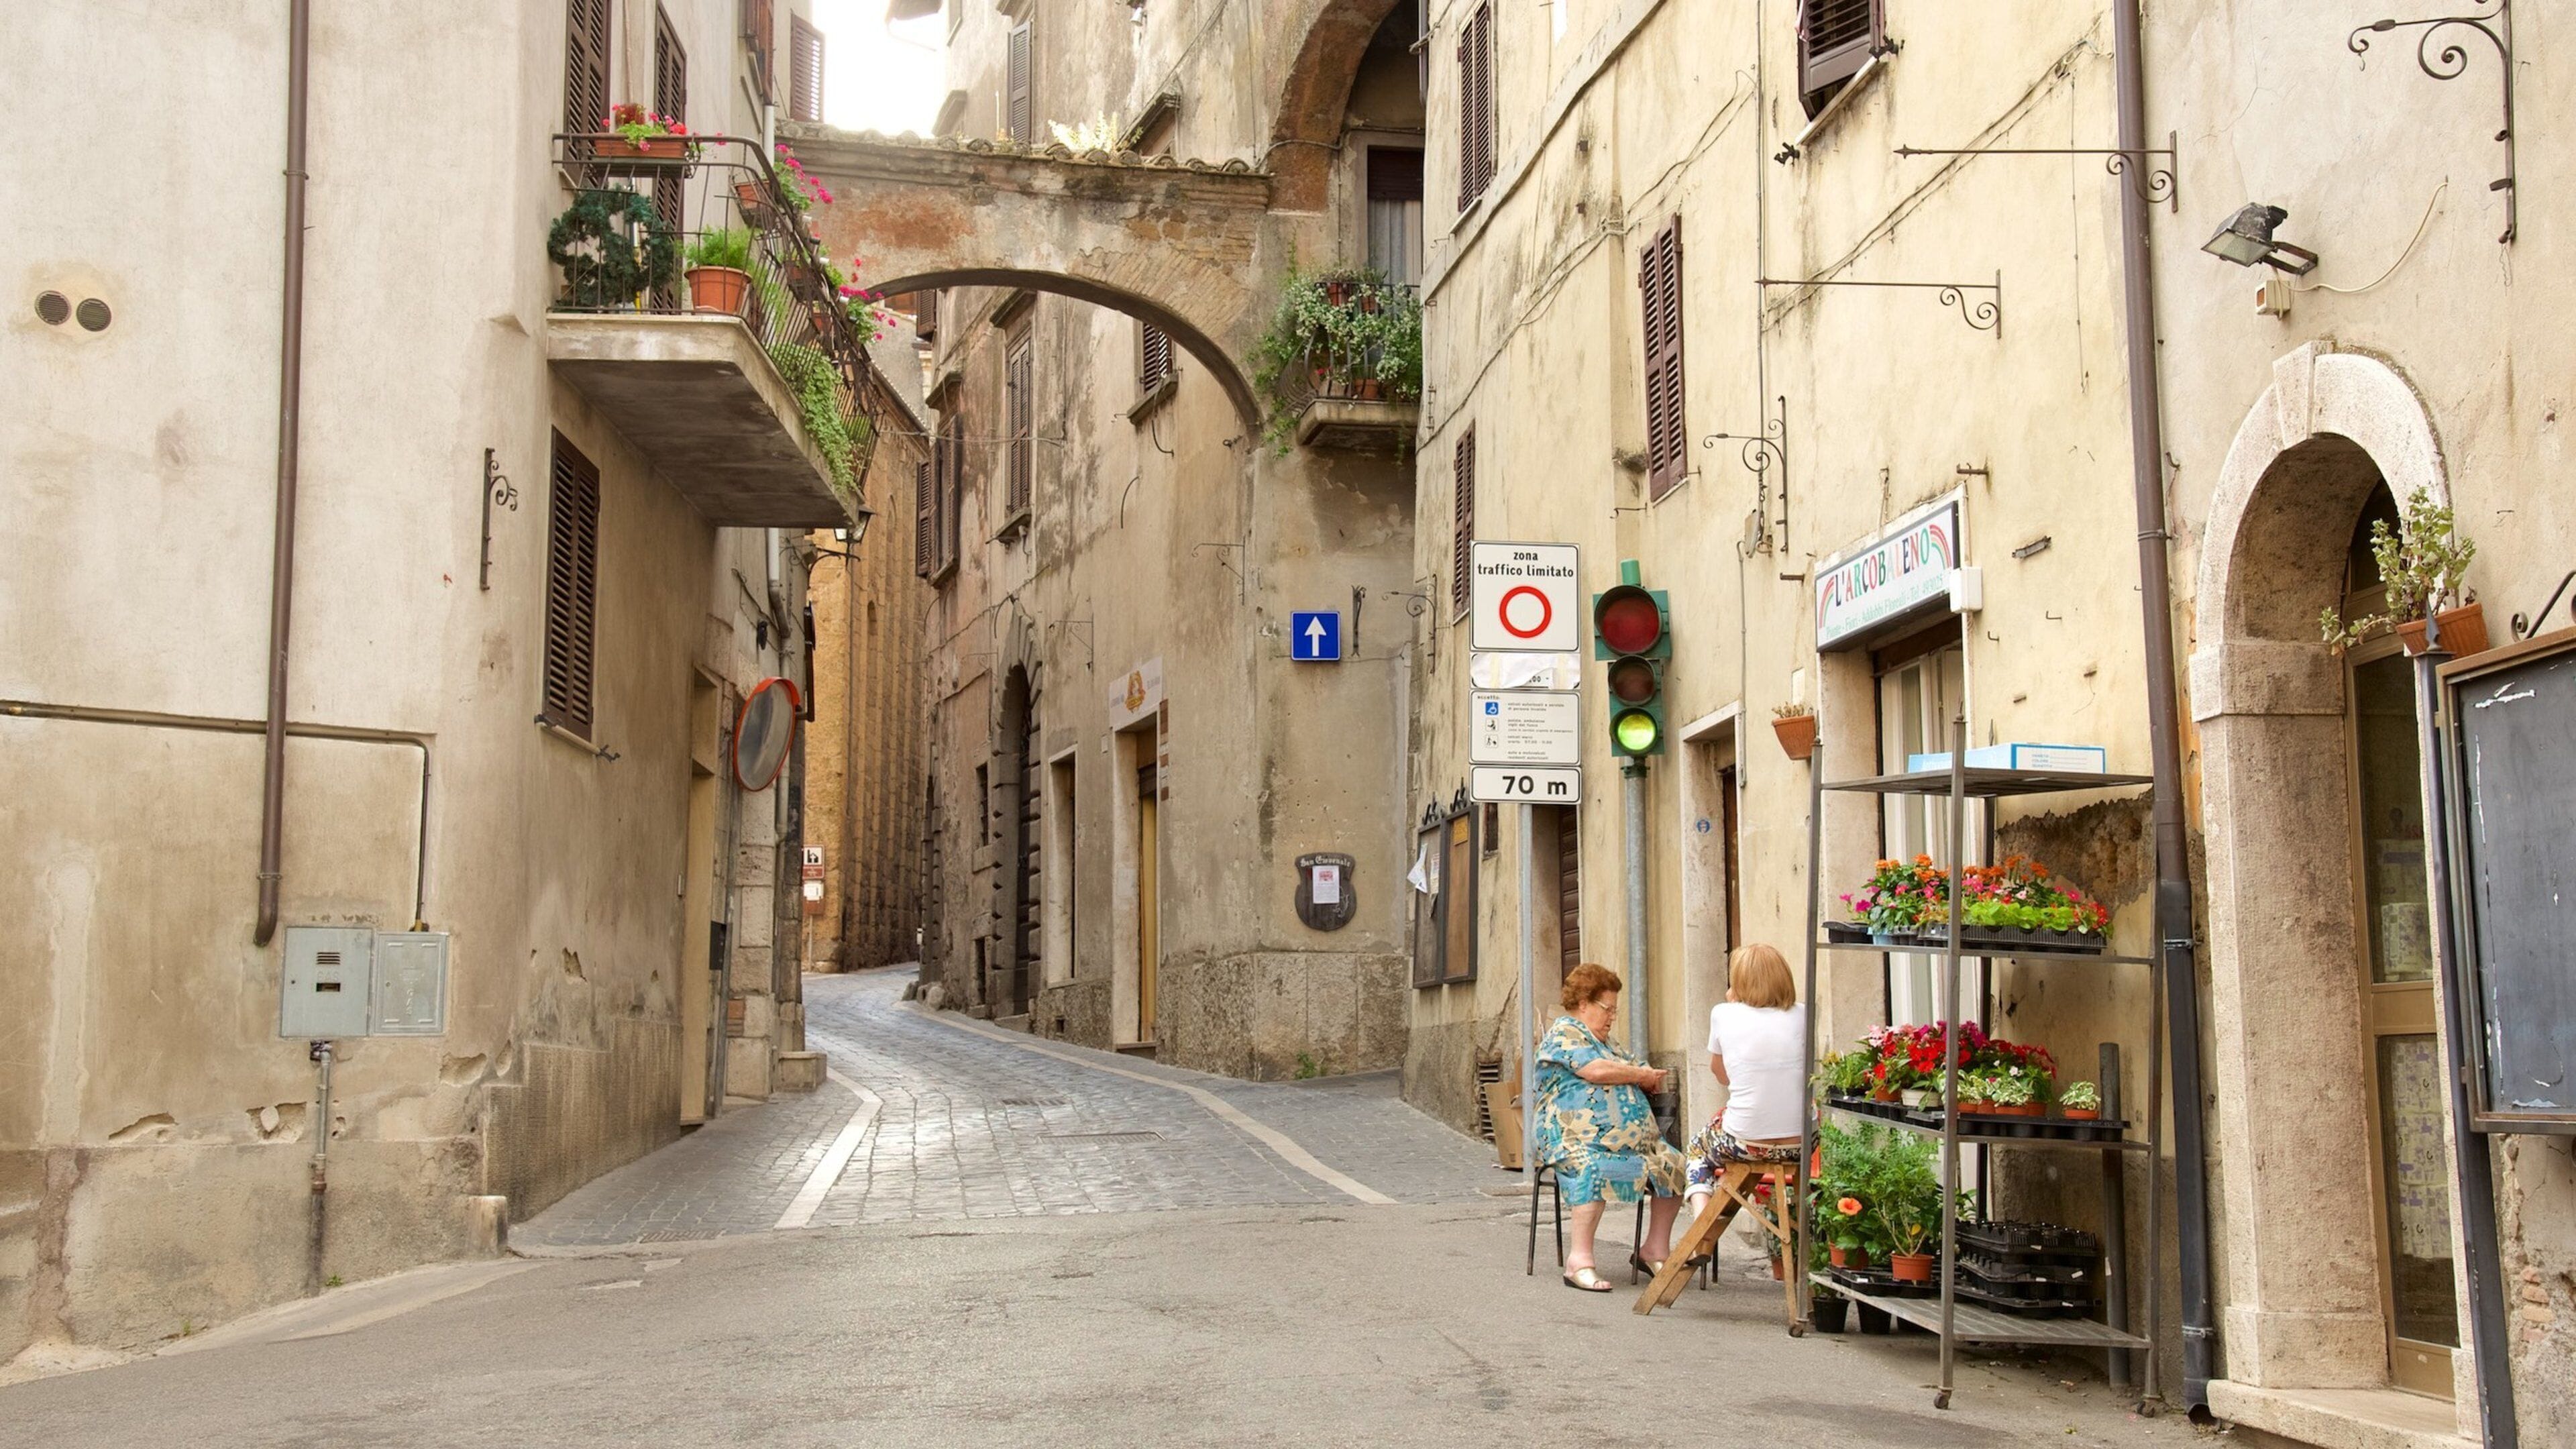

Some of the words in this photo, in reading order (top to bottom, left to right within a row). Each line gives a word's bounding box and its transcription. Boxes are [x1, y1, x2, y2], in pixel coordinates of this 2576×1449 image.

[1513, 552, 1538, 561] zona
[1478, 564, 1522, 576] traffico
[1527, 566, 1574, 577] limitato
[1835, 528, 1931, 606] L'ARCOBALENO
[1502, 775, 1534, 794] 70
[1548, 782, 1567, 795] m
[317, 971, 339, 981] GAS
